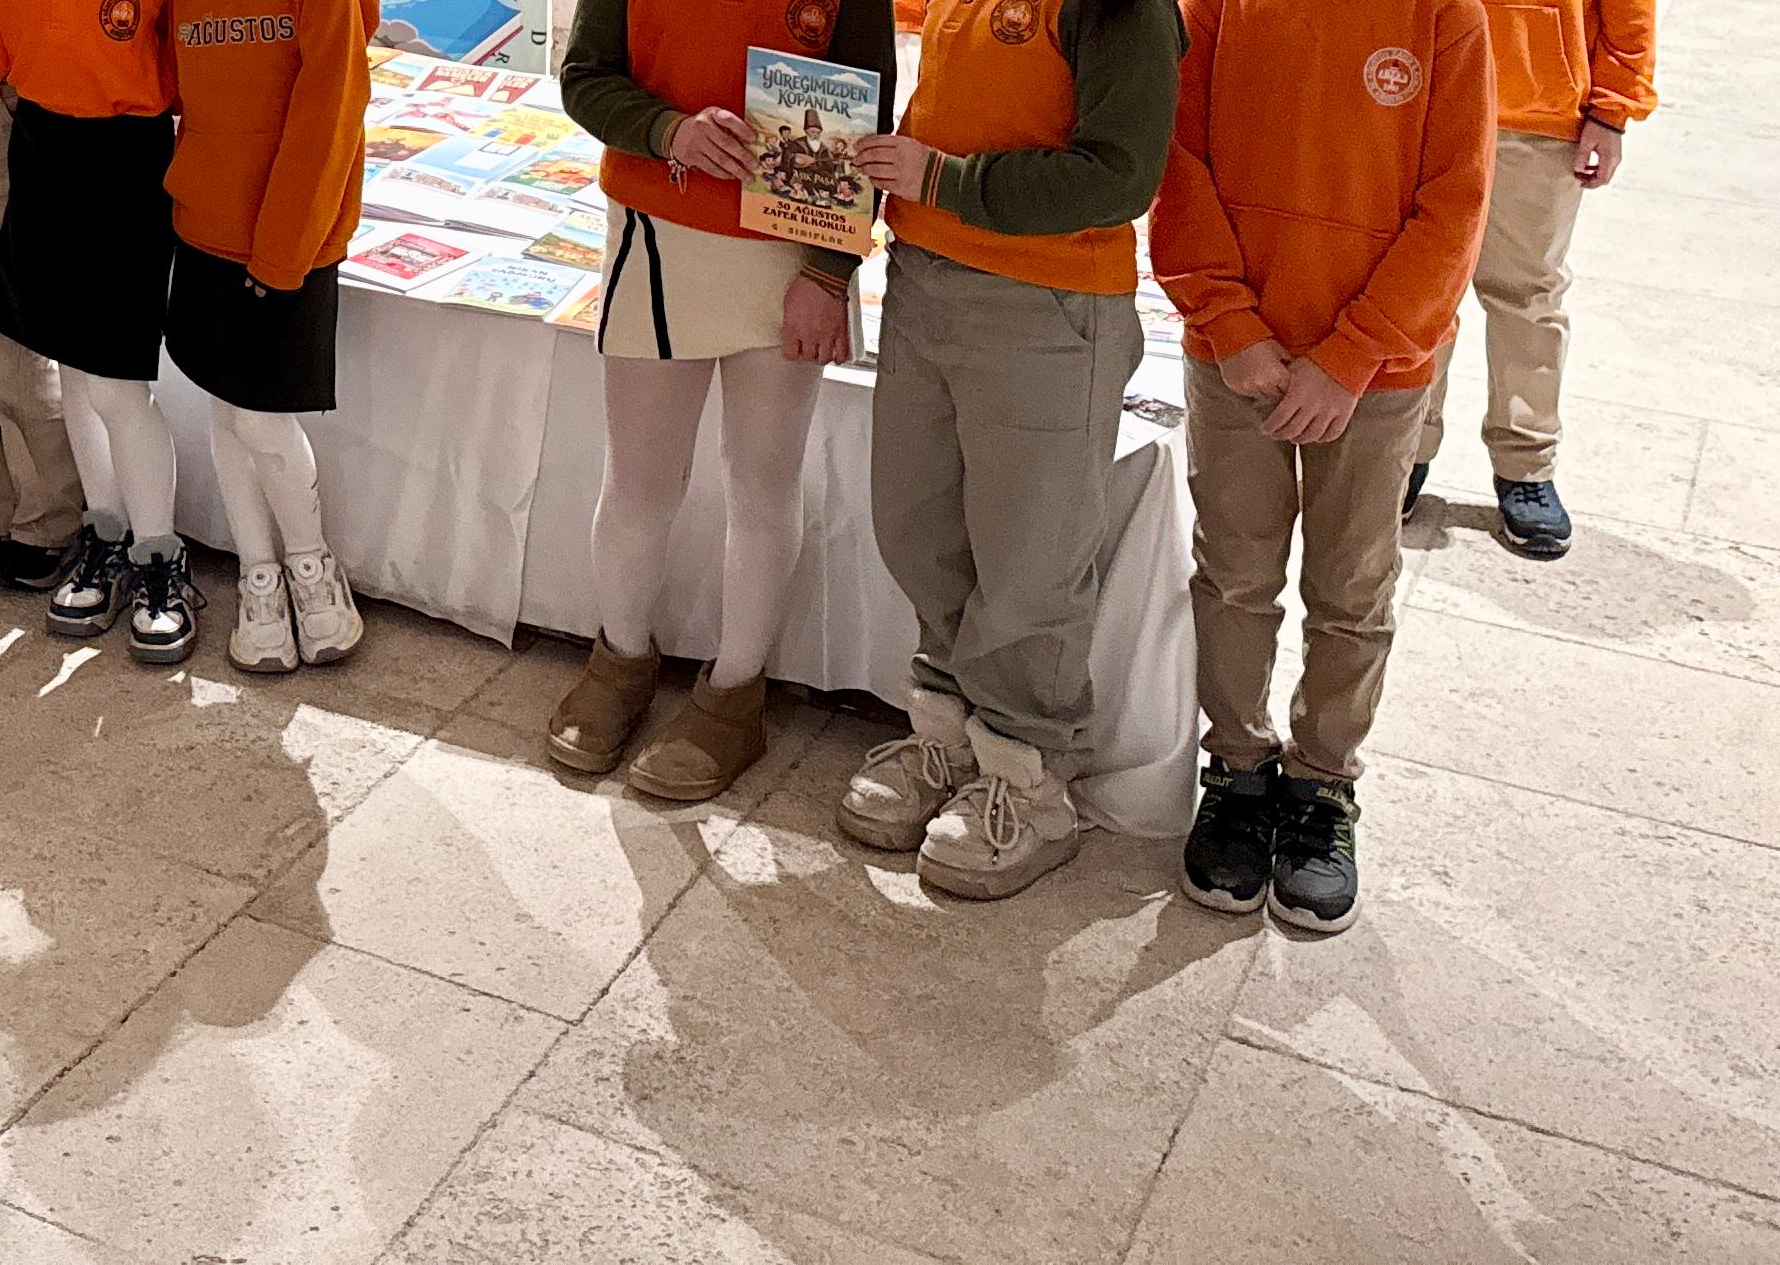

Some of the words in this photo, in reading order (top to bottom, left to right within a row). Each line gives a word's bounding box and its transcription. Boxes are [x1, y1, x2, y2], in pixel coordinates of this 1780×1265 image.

[531, 29, 547, 45] D
[495, 51, 510, 64] R
[762, 65, 868, 103] YÜREĞİMİZDEN
[778, 89, 852, 119] KOPANLAR
[763, 206, 798, 222] ZAFER
[800, 214, 856, 234] İLKOKULU
[777, 200, 791, 211] 30
[795, 205, 846, 223] AĞUSTOS
